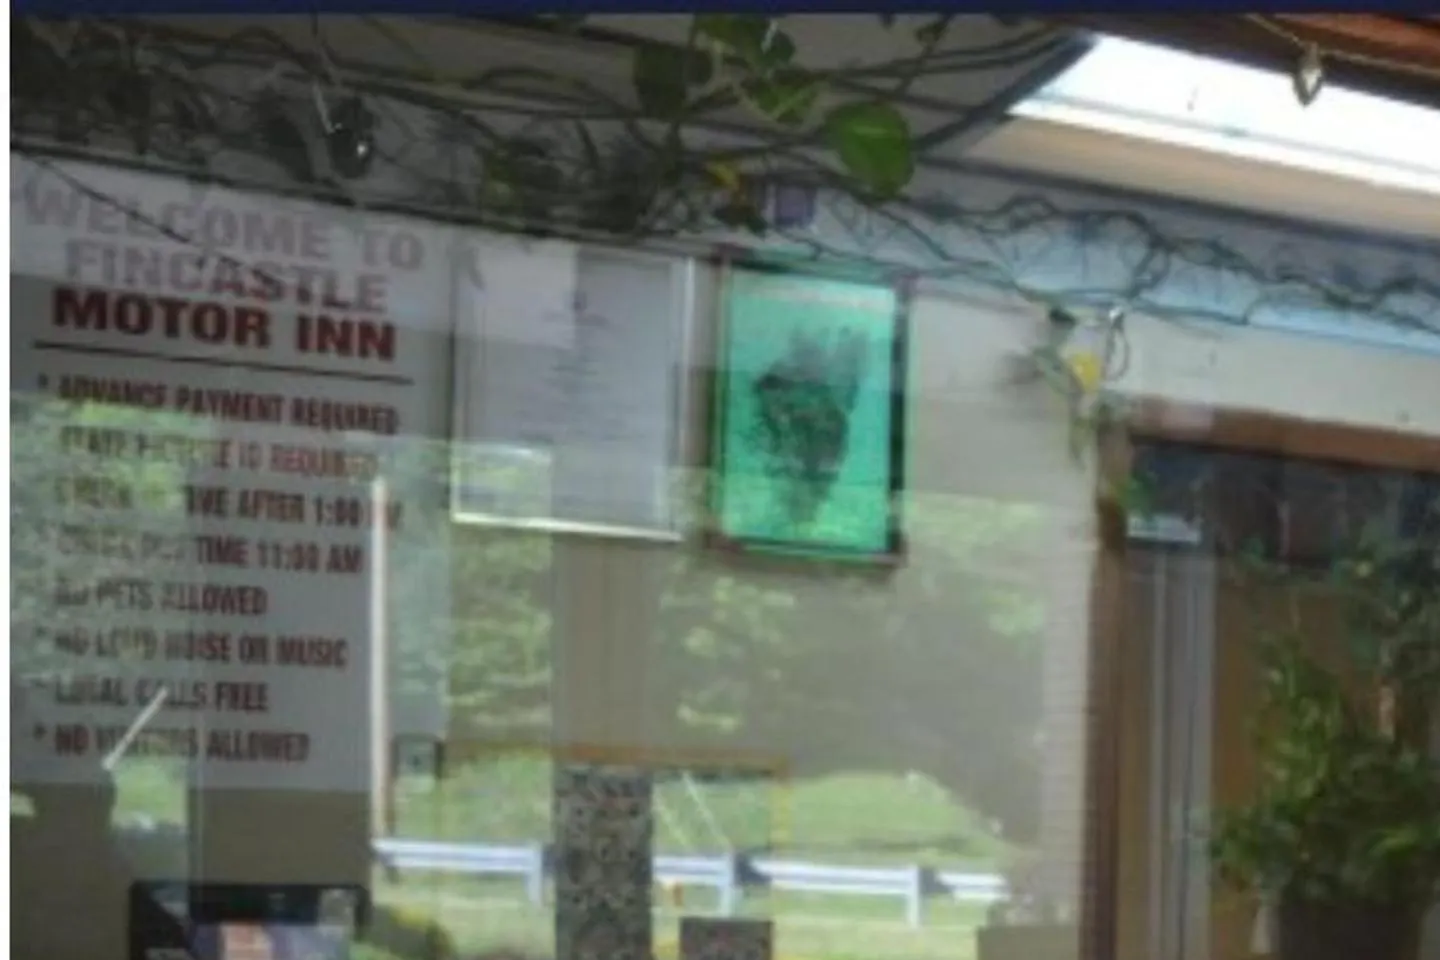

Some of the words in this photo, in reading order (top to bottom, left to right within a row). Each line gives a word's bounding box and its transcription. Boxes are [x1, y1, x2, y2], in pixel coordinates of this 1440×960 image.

[23, 176, 331, 260] WELCOME
[358, 226, 428, 270] TO
[64, 238, 391, 313] FINCASTLE
[51, 286, 271, 349] MOTOR
[295, 314, 396, 361] INN
[57, 373, 169, 408] ADVANCE
[176, 384, 285, 423] PAYMENT
[289, 396, 401, 435] REQUIRED
[236, 489, 306, 524] AFTER
[369, 499, 402, 532] M
[194, 534, 249, 569] TIME
[256, 540, 321, 574] 11:00
[325, 543, 364, 575] AM
[95, 577, 155, 613] PETS
[160, 580, 269, 618] ALLOWED
[164, 631, 232, 666] NOISE
[238, 634, 269, 666] OR
[275, 635, 351, 670] MUSIC
[54, 677, 128, 709] LOCAL
[213, 682, 270, 715] FREE
[54, 723, 90, 758] NO
[205, 728, 311, 765] ALLOWED
